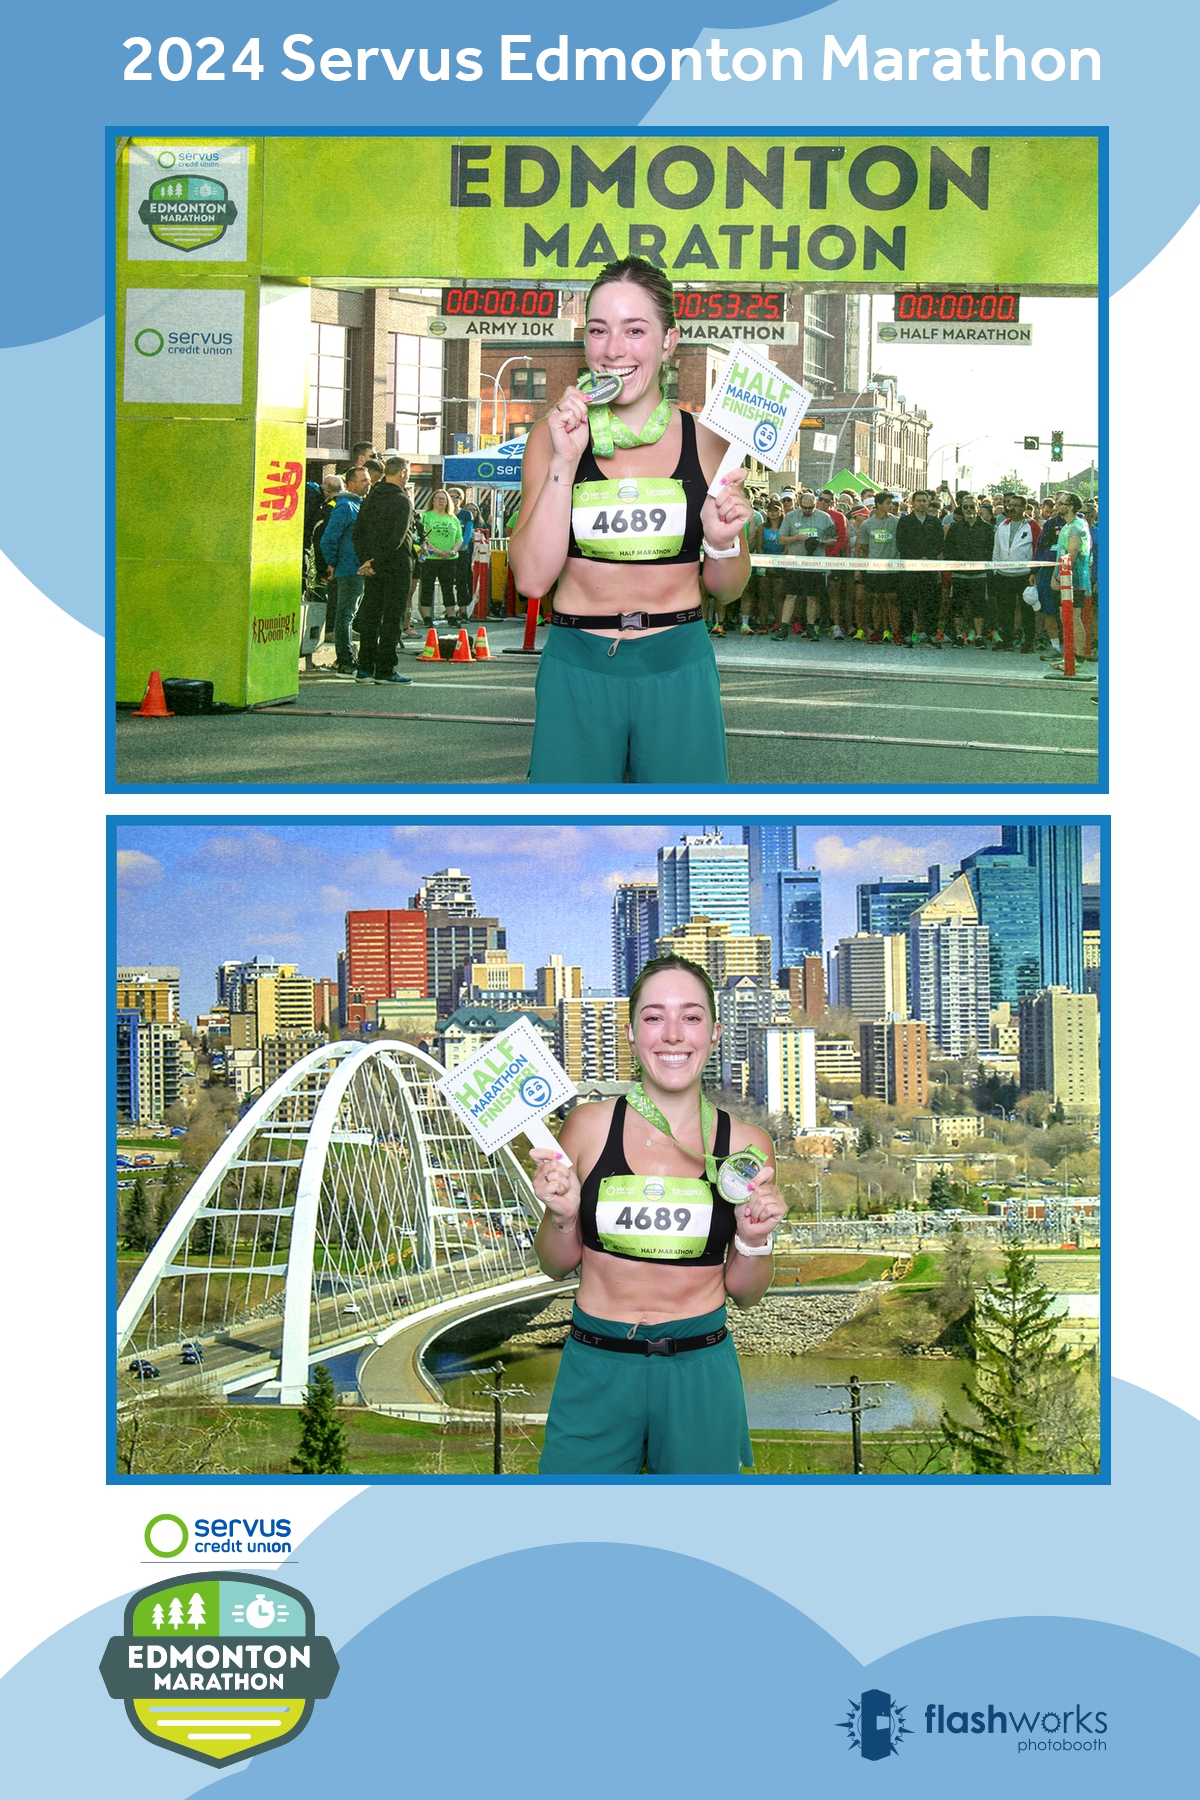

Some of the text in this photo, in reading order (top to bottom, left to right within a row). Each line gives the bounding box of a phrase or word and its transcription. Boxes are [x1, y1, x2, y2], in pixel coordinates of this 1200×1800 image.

[178, 152, 220, 161] servus
[450, 144, 990, 212] EDMONTON
[149, 203, 227, 214] EDMONTON
[160, 214, 215, 222] MARATHON
[523, 222, 906, 271] MARATHON
[168, 332, 233, 345] servus
[465, 321, 555, 336] ARMY 10K
[680, 325, 785, 340] MARATHON
[900, 328, 939, 340] HALF
[943, 328, 1031, 341] MARATHON
[167, 345, 233, 355] credit union
[730, 362, 794, 404] HALF
[726, 384, 787, 418] MARATHON
[721, 395, 785, 431] FINISHER!
[592, 507, 667, 534] 4689
[636, 548, 672, 556] MARATHON
[454, 1037, 515, 1109] HALF
[469, 1053, 529, 1118] MARATHON
[477, 1062, 540, 1129] FINISHER!
[615, 1206, 692, 1231] 4689
[640, 1247, 657, 1255] HALF
[657, 1248, 694, 1256] MARATHON
